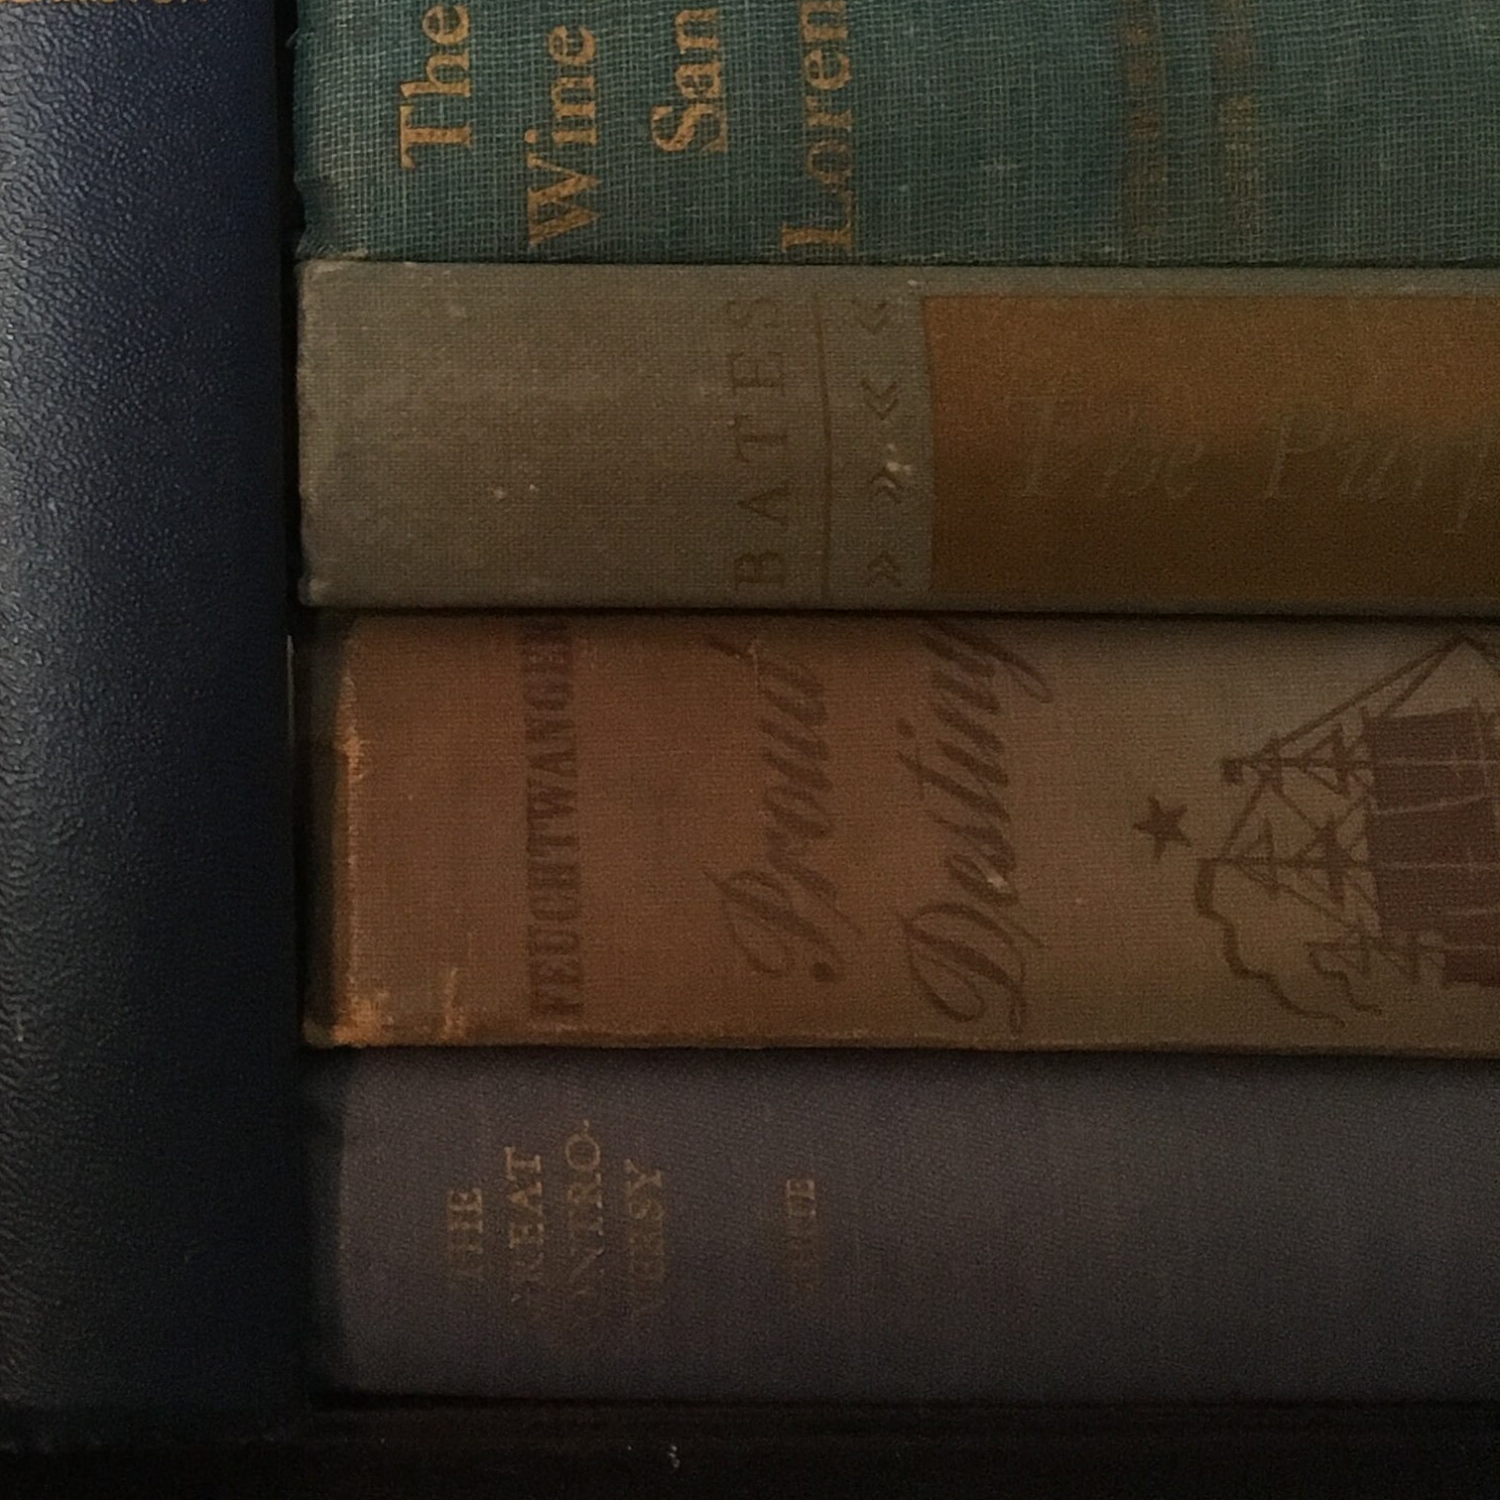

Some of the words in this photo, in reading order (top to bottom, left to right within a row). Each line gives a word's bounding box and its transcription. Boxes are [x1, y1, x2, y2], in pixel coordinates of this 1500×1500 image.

[399, 3, 473, 173] The
[523, 24, 602, 249] Wine
[650, 6, 730, 155] San
[725, 296, 791, 592] BATES
[895, 617, 1053, 1036] Destiny
